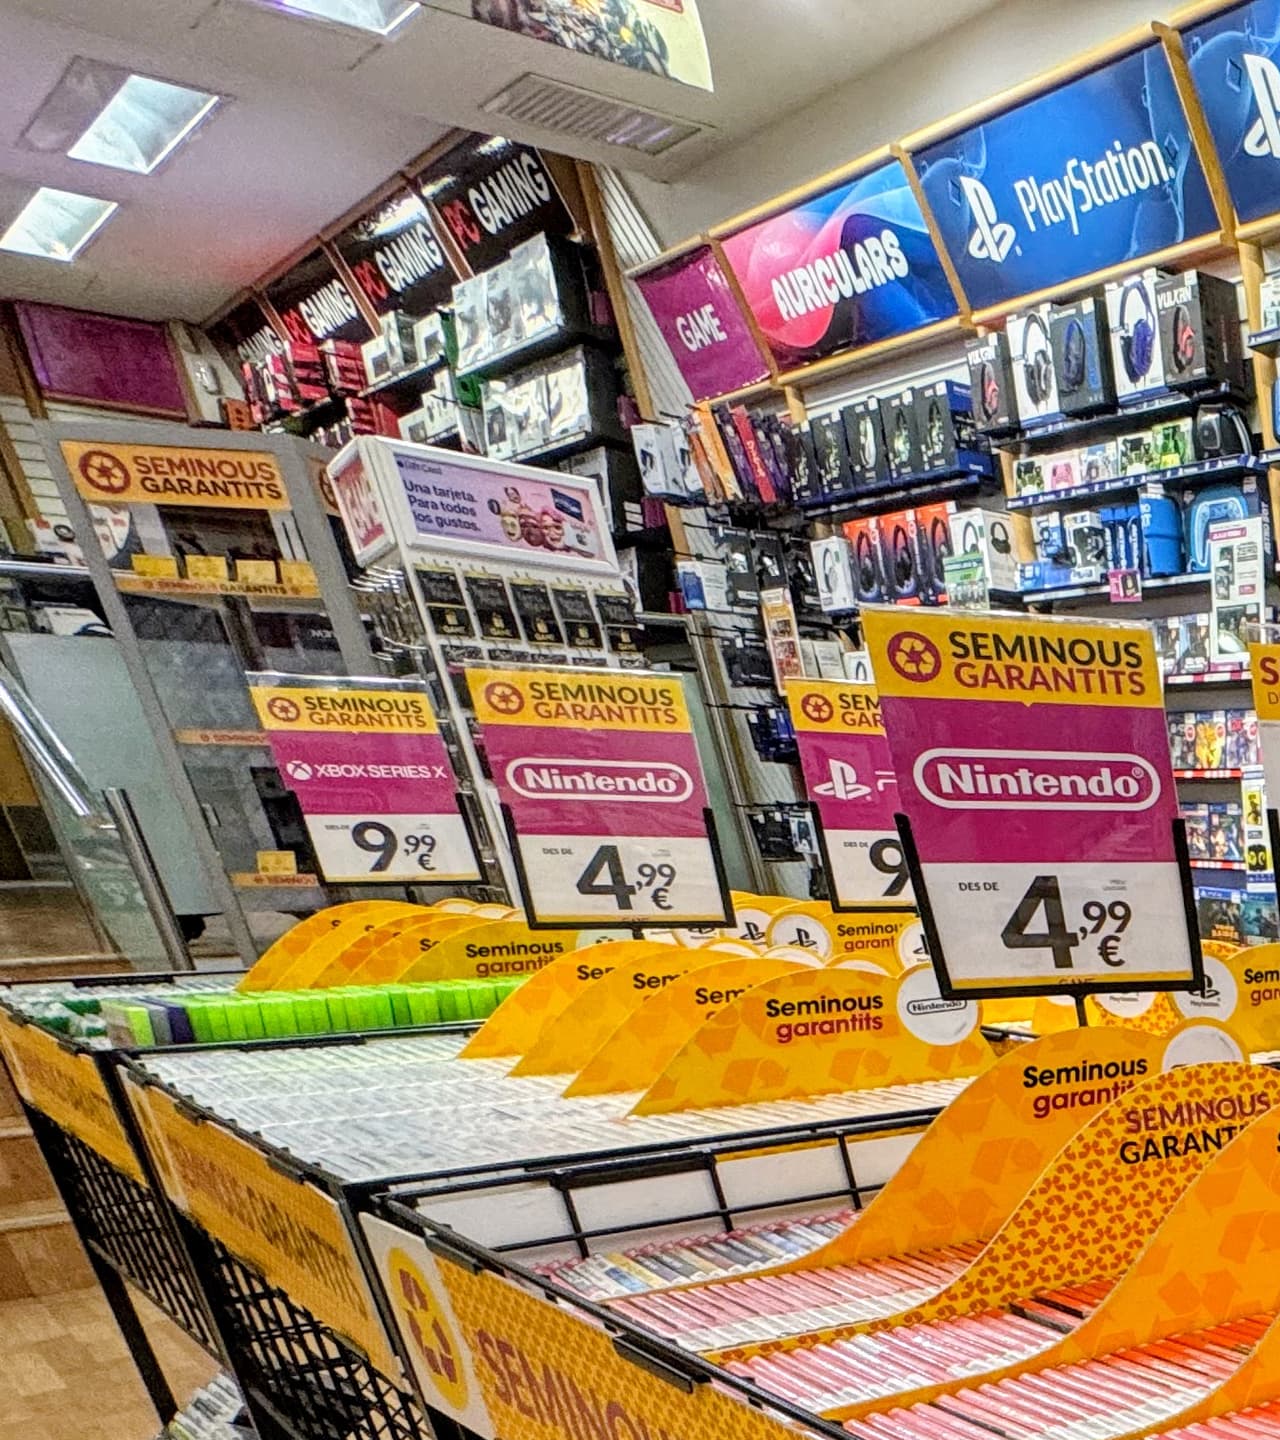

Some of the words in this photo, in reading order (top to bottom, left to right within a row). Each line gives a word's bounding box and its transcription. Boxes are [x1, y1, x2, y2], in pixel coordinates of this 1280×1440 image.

[443, 199, 481, 250] PC
[469, 154, 550, 234] GAMING
[354, 260, 387, 300] PC
[375, 223, 444, 291] GAMING
[769, 229, 909, 321] AURICULARS
[301, 279, 357, 339] GAMING
[676, 303, 727, 351] GAME
[134, 455, 277, 482] SEMINOUS
[141, 477, 282, 499] GARANTITS
[403, 480, 431, 495] Una
[408, 494, 439, 511] Para
[442, 500, 477, 518] todos
[949, 631, 1142, 668] SEMINOUS
[955, 662, 1146, 695] GARANTITS
[303, 694, 424, 715] SEMINOUS
[529, 680, 674, 707] SEMINOUS
[309, 708, 426, 729] GARANTITS
[534, 702, 677, 725] GARANTITS
[314, 764, 357, 778] XBOX
[358, 763, 430, 778] SERIES
[432, 764, 447, 778] X
[523, 768, 677, 793] Nintendo
[937, 763, 1140, 798] Nintendo
[418, 853, 432, 870] €
[652, 886, 671, 909] €
[958, 881, 978, 891] DES
[981, 881, 999, 891] DE
[466, 939, 564, 959] Seminous
[1098, 935, 1125, 966] €
[766, 992, 884, 1019] Seminous
[775, 1011, 883, 1044] garantits
[1023, 1058, 1148, 1088] Seminous
[1125, 1092, 1270, 1134] SEMINOUS
